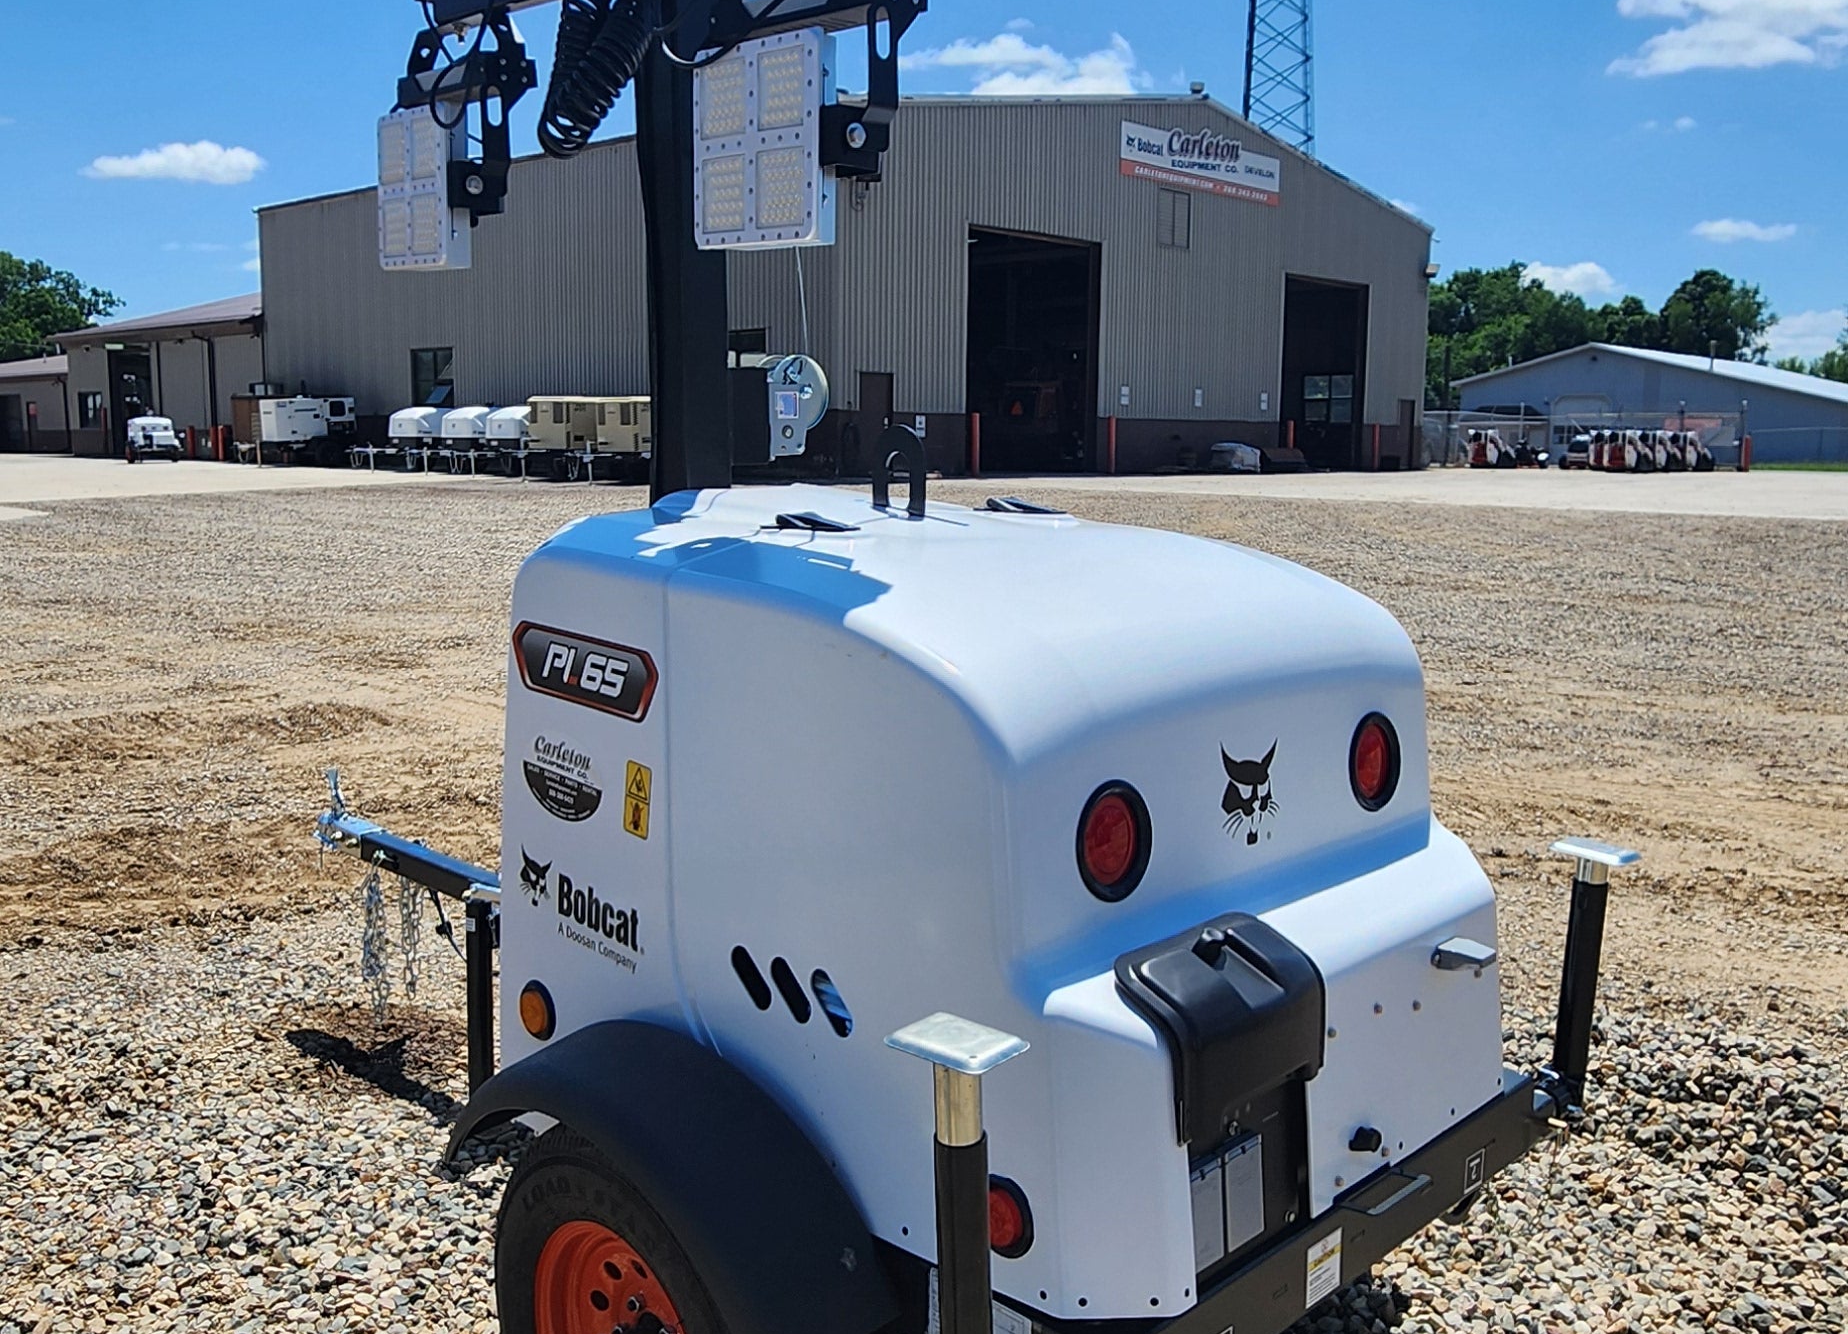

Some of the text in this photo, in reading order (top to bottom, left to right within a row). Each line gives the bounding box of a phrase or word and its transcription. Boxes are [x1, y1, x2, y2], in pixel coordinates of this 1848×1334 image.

[1137, 137, 1164, 156] Bobcat
[1167, 129, 1240, 161] Carleton
[1171, 159, 1239, 174] EQUIPMENT CO.
[534, 735, 592, 771] Carleton
[537, 754, 575, 775] EQUIPMENT
[558, 872, 639, 953] Bobcat
[557, 922, 638, 975] A Doosan Company
